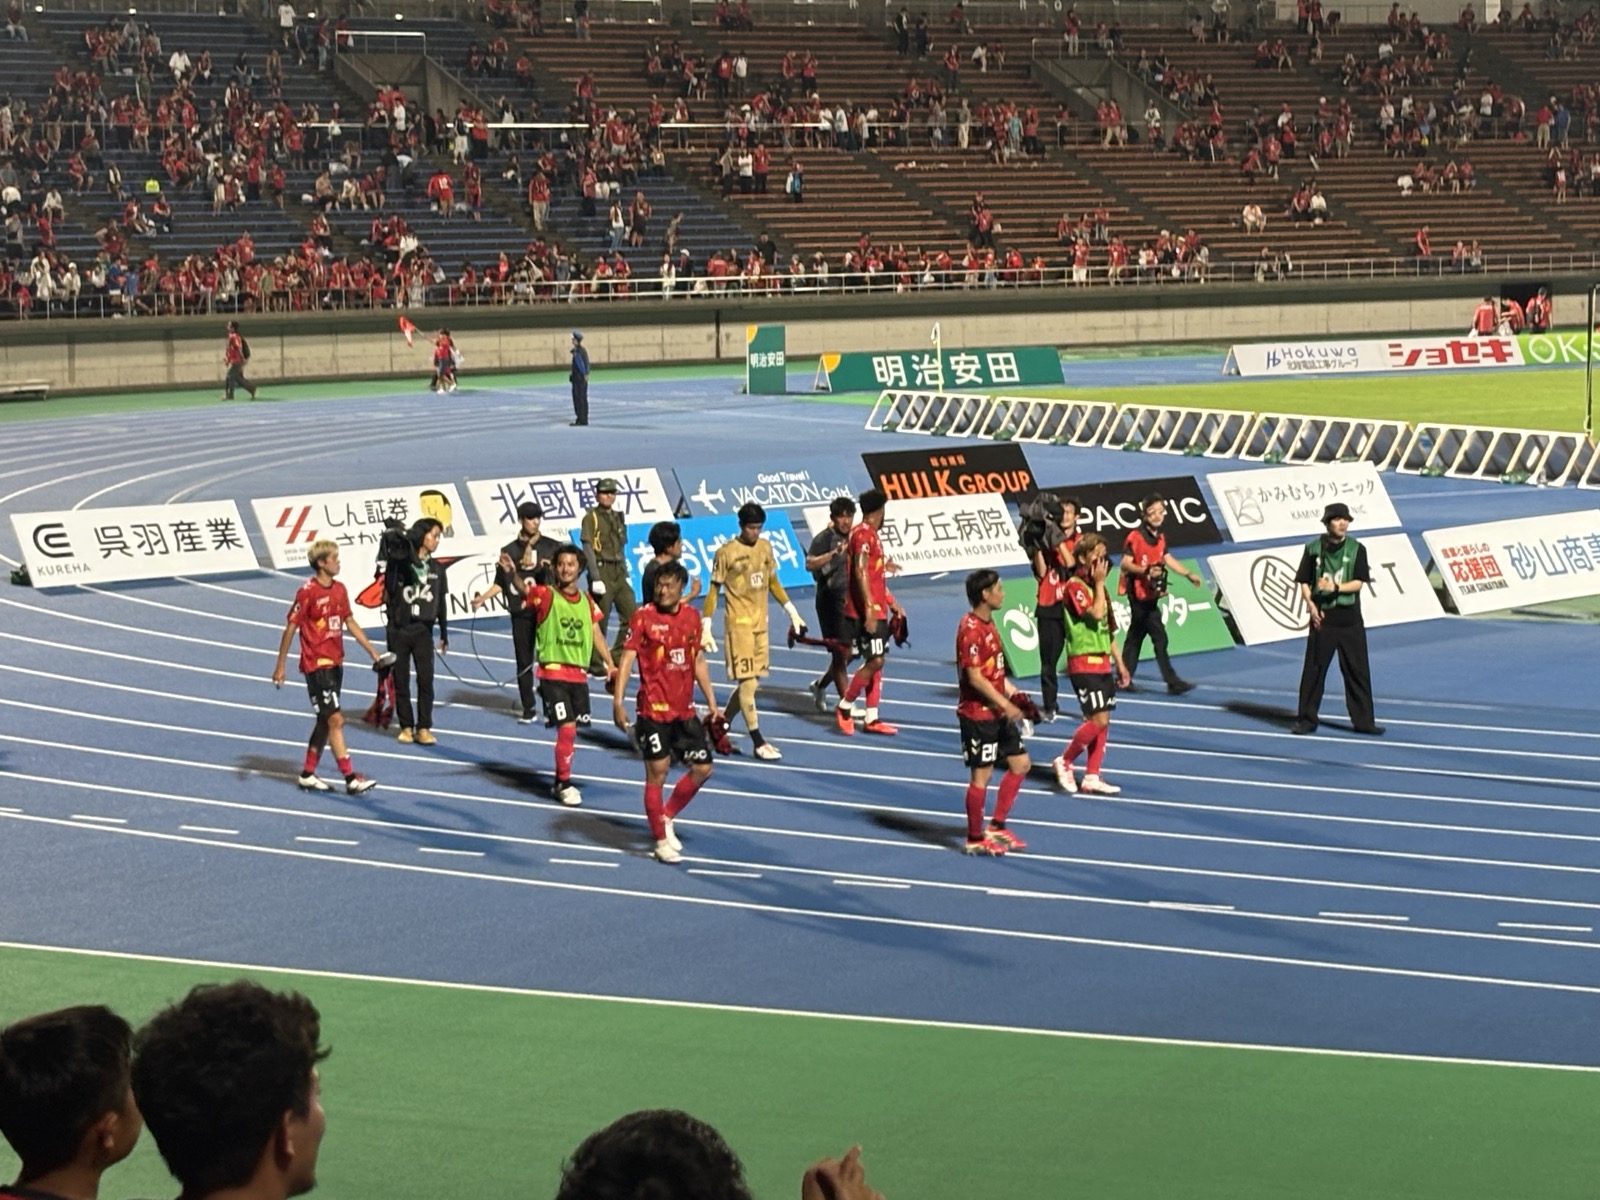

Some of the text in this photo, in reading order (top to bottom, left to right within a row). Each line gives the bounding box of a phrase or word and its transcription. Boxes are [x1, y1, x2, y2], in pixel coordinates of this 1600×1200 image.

[750, 351, 785, 369] 明治安田
[1281, 345, 1358, 360] Hokuwa
[1388, 339, 1514, 368] ショセキ
[872, 352, 1021, 388] 明治安田
[757, 471, 781, 484] Good
[880, 469, 1031, 500] HULK GROUP
[731, 481, 821, 506] VACATION
[1258, 478, 1375, 503] かみむらクリニック
[1076, 497, 1207, 534] PACIC
[94, 517, 244, 559] 呉羽産業
[335, 529, 384, 547] さか
[964, 541, 1018, 557] HOSPITAL
[37, 563, 92, 577] KUREHA
[1448, 554, 1503, 583] 応援団
[870, 637, 884, 655] 10
[740, 657, 754, 674] 31
[555, 702, 567, 721] 8
[649, 733, 662, 754] 3
